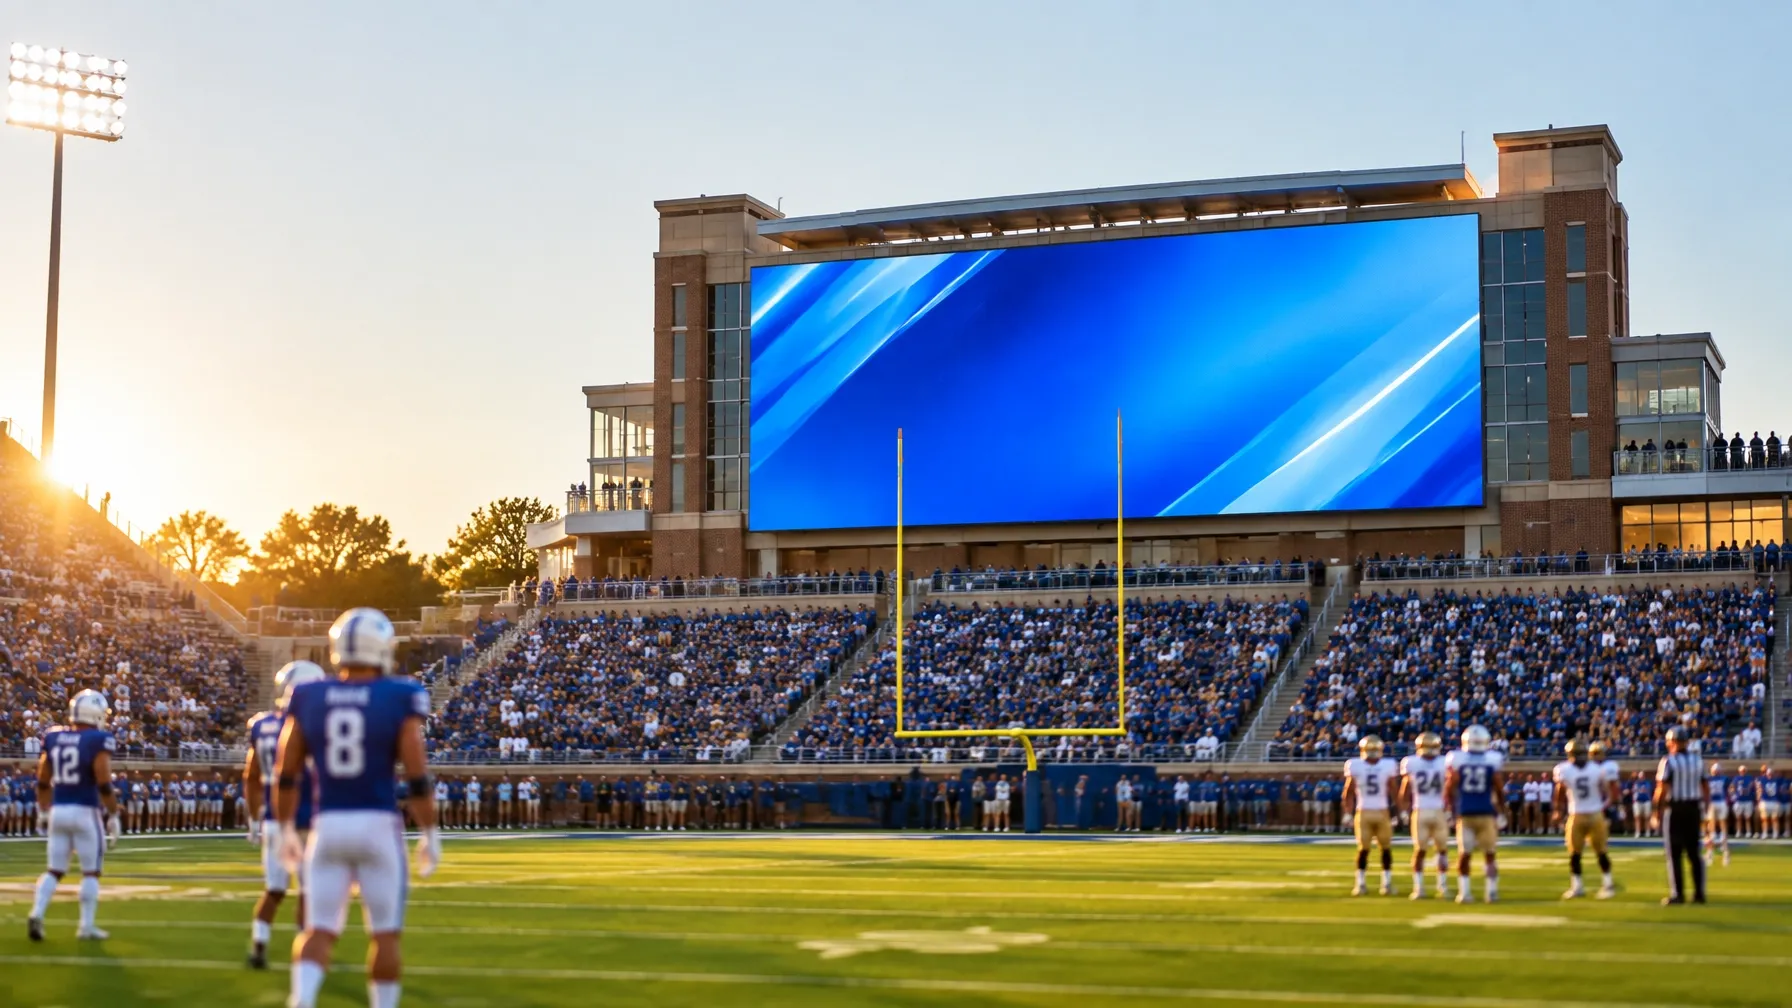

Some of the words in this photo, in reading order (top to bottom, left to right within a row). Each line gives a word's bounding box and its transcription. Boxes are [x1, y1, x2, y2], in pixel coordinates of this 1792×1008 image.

[326, 707, 365, 778] 8
[51, 746, 80, 784] 12
[1366, 775, 1379, 795] 5
[1416, 771, 1442, 795] 24
[1574, 777, 1590, 799] 5
